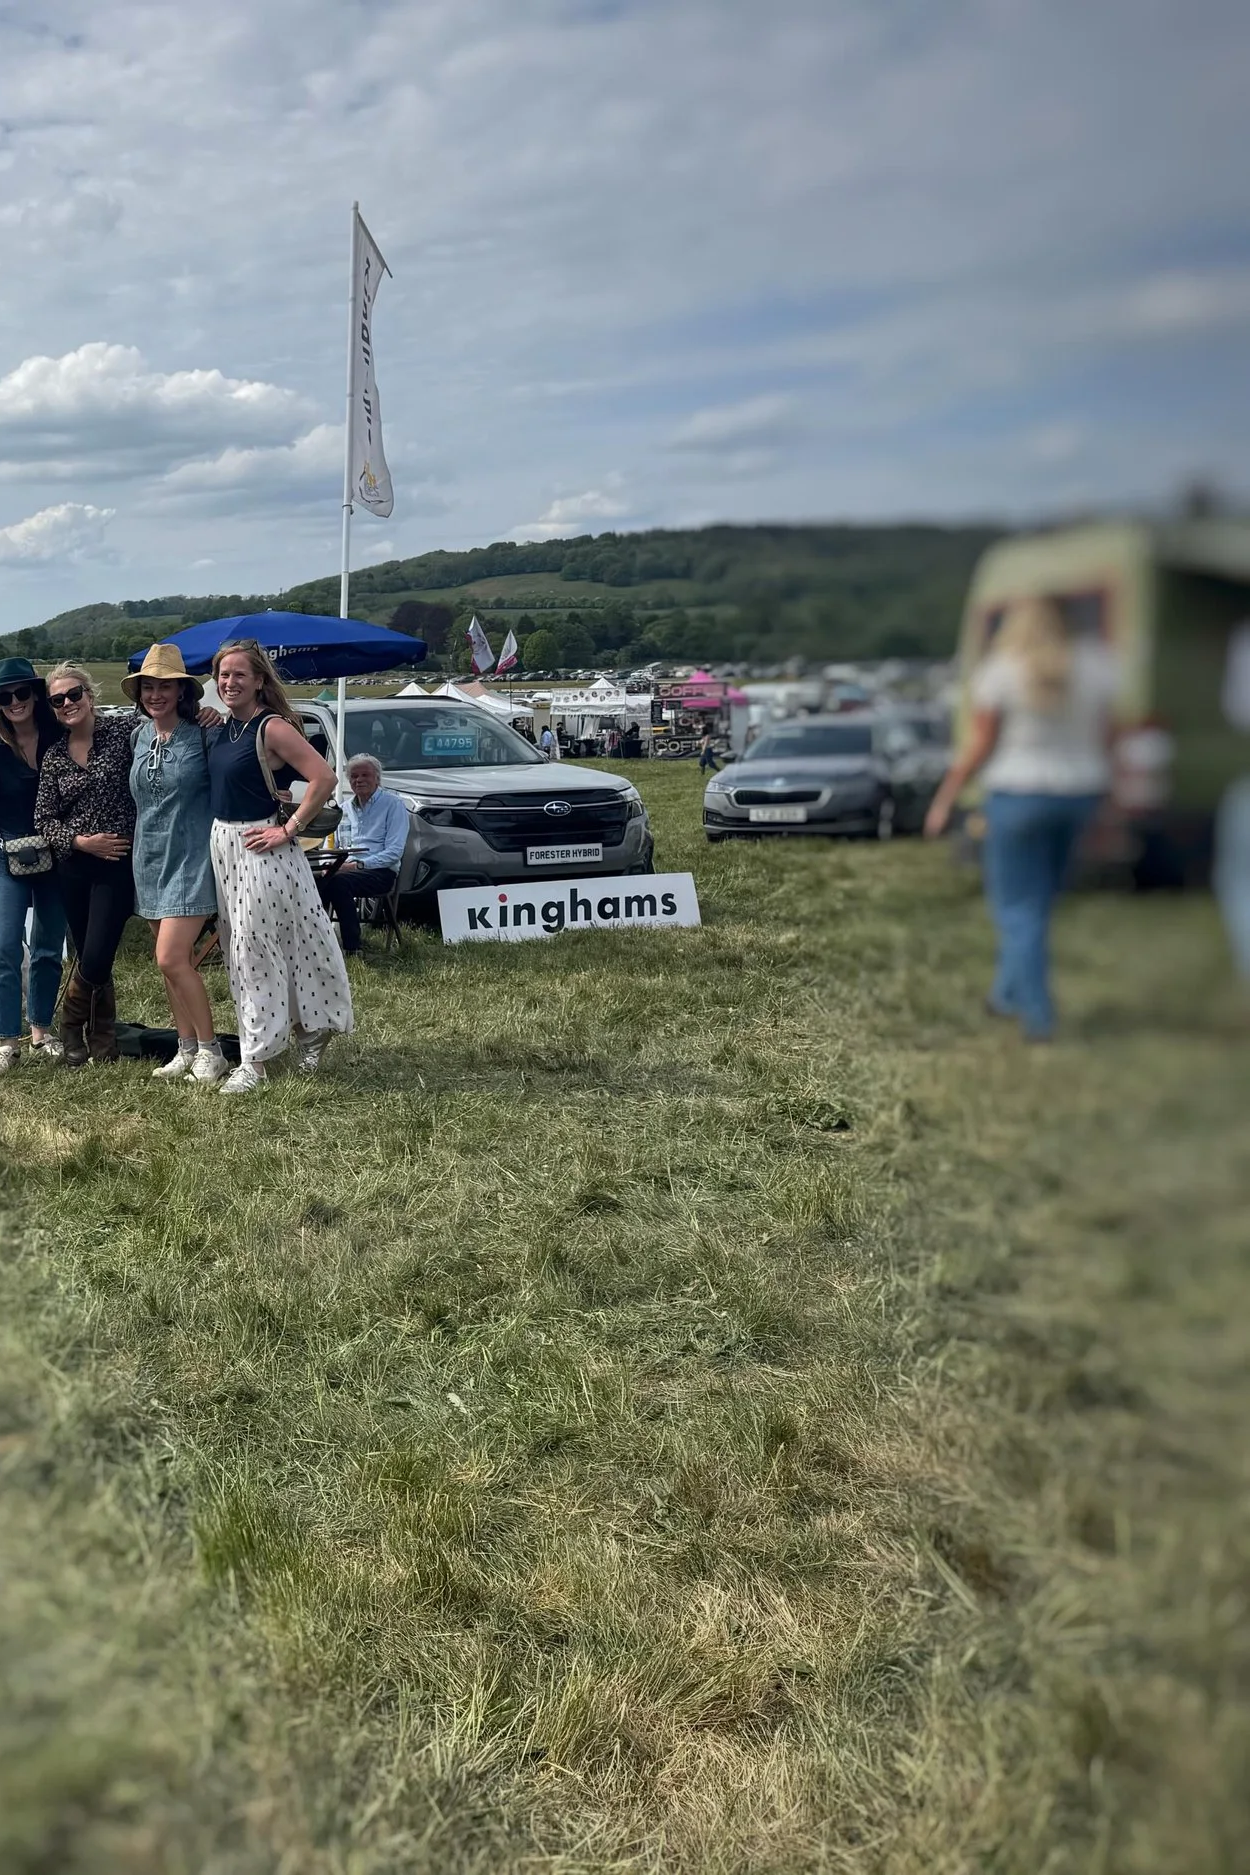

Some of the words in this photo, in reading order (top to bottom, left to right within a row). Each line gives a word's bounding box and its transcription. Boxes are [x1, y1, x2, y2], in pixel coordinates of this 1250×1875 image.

[659, 686, 718, 697] COFF
[530, 850, 570, 860] FORESTER
[572, 848, 600, 858] HYBRID
